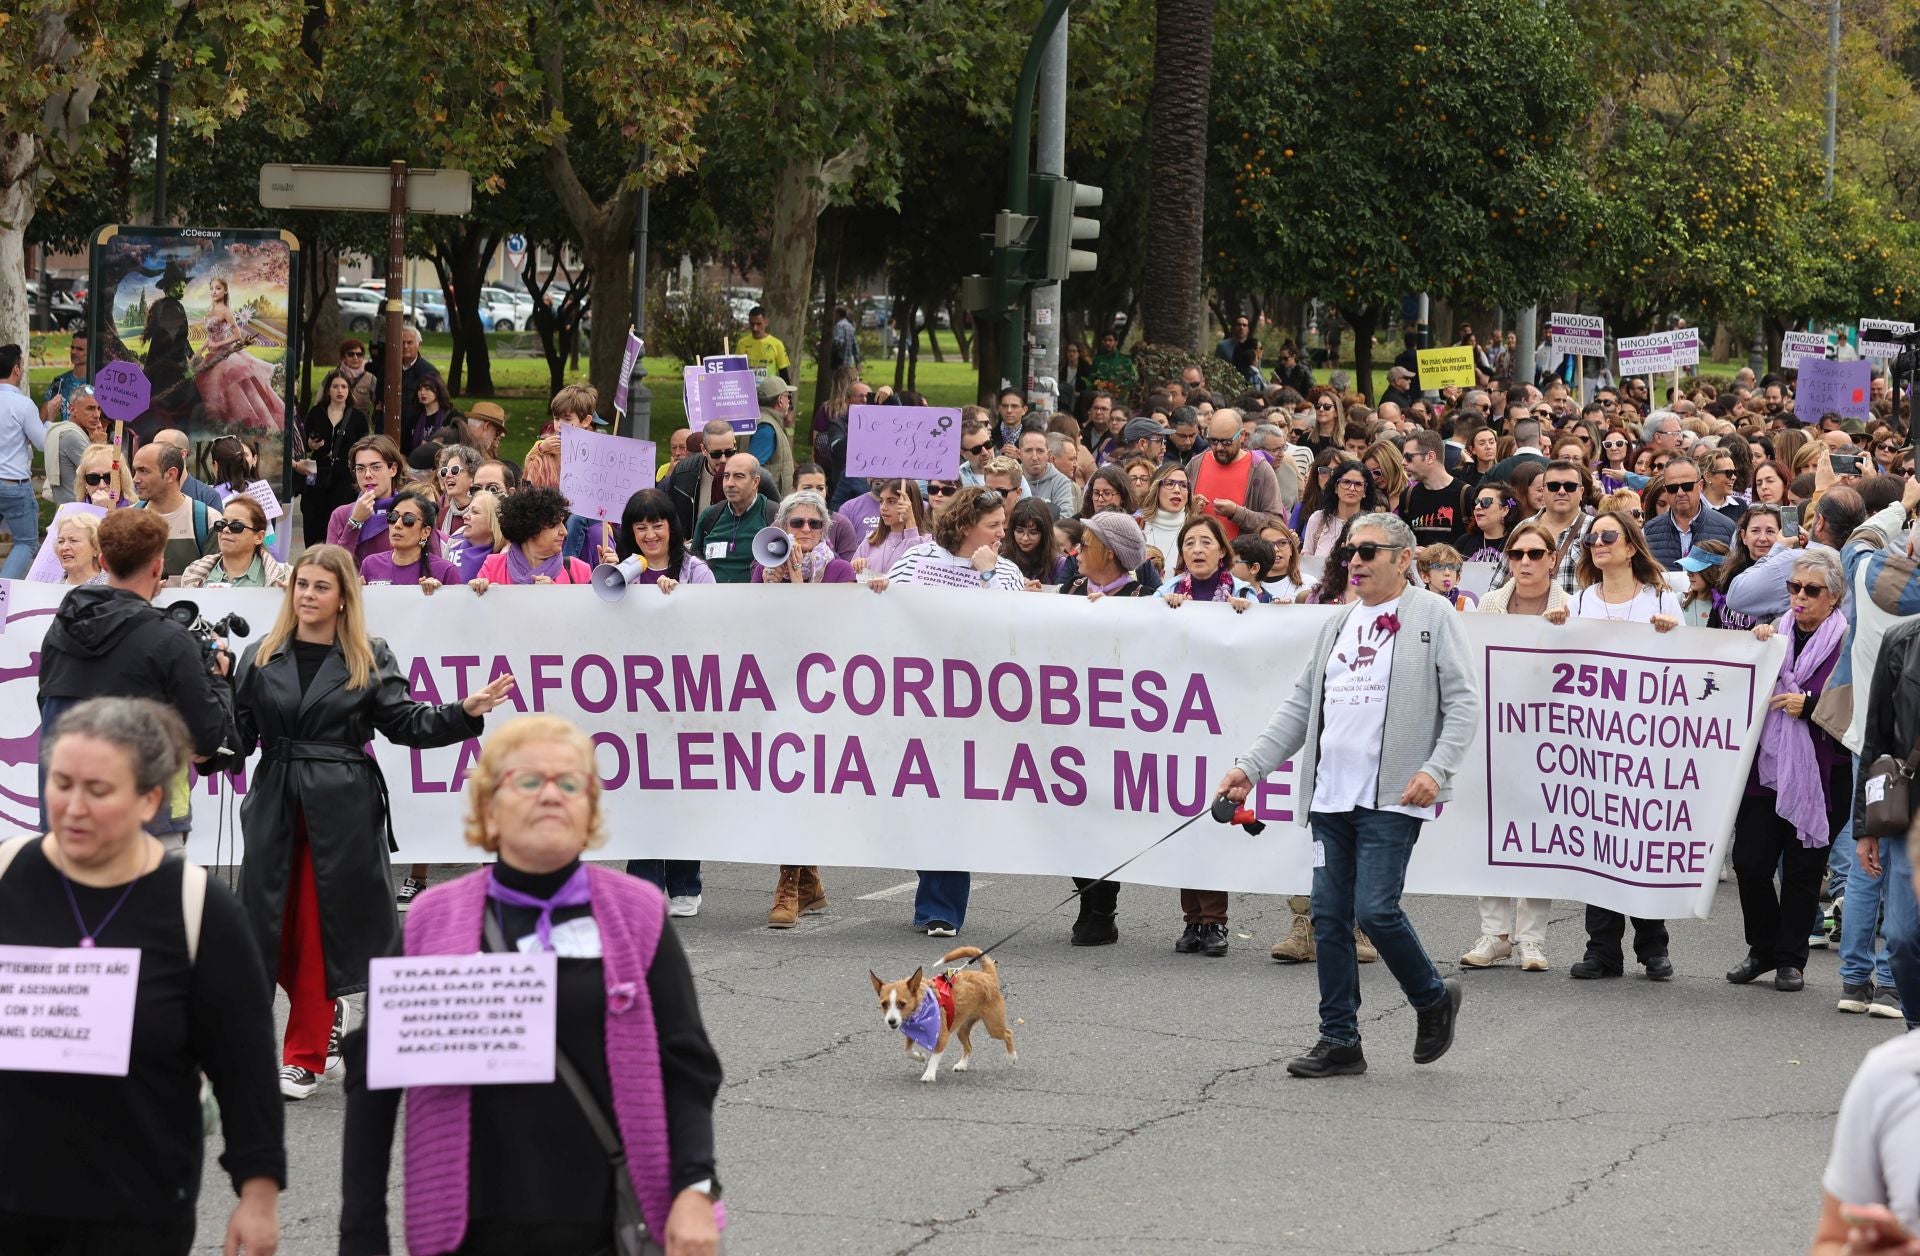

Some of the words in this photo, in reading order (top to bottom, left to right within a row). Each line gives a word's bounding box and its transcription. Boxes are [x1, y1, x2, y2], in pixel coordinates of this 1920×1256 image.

[180, 229, 221, 238] JCDecaux
[1554, 316, 1600, 328] HINOJOSA
[1564, 328, 1590, 337] CONTRA
[1786, 333, 1825, 344] HINOJOSA
[1564, 337, 1602, 346] VIOLENCIA
[1620, 336, 1670, 349] HINOJOSA
[1793, 344, 1815, 352] CONTRA
[1569, 345, 1598, 355] GÉNERO
[1632, 348, 1659, 357] CONTRA
[1429, 357, 1441, 365] más
[1442, 355, 1466, 364] violencia
[1632, 355, 1671, 364] VIOLENCIA
[708, 361, 724, 373] SE
[1422, 366, 1439, 374] contra
[1450, 364, 1472, 373] mujeres
[1626, 366, 1636, 374] DE
[104, 369, 137, 386] STOP
[569, 440, 589, 464] NO
[925, 565, 970, 578] TRABAJAR
[918, 569, 962, 582] IGUALDAD
[964, 580, 981, 588] PAR
[1551, 662, 1626, 702] 25N
[1639, 666, 1689, 707] DÍA
[794, 653, 1221, 735] CORDOBESA
[1498, 702, 1740, 751] INTERNACIONAL
[893, 739, 939, 797] A
[964, 741, 1087, 806] LAS
[1536, 742, 1655, 788] CONTRA
[1665, 758, 1700, 790] LA
[1541, 782, 1692, 832] VIOLENCIA
[1502, 821, 1523, 851] A
[1531, 823, 1586, 857] LAS
[57, 962, 71, 975] DE
[75, 962, 102, 975] ESTE
[106, 960, 131, 976] AÑO
[392, 966, 503, 979] TRABAJAR
[510, 965, 536, 975] LA
[19, 984, 90, 996] ASESINARON
[379, 982, 486, 995] IGUALDAD
[492, 978, 547, 990] PARA
[383, 995, 506, 1010] CONSTRUIR
[513, 994, 544, 1006] UN
[5, 1004, 29, 1016] CON
[402, 1011, 480, 1024] MUNDO
[487, 1009, 523, 1021] SIN
[31, 1025, 91, 1041] GONZÁLEZ
[398, 1026, 527, 1039] VIOLENCIAS
